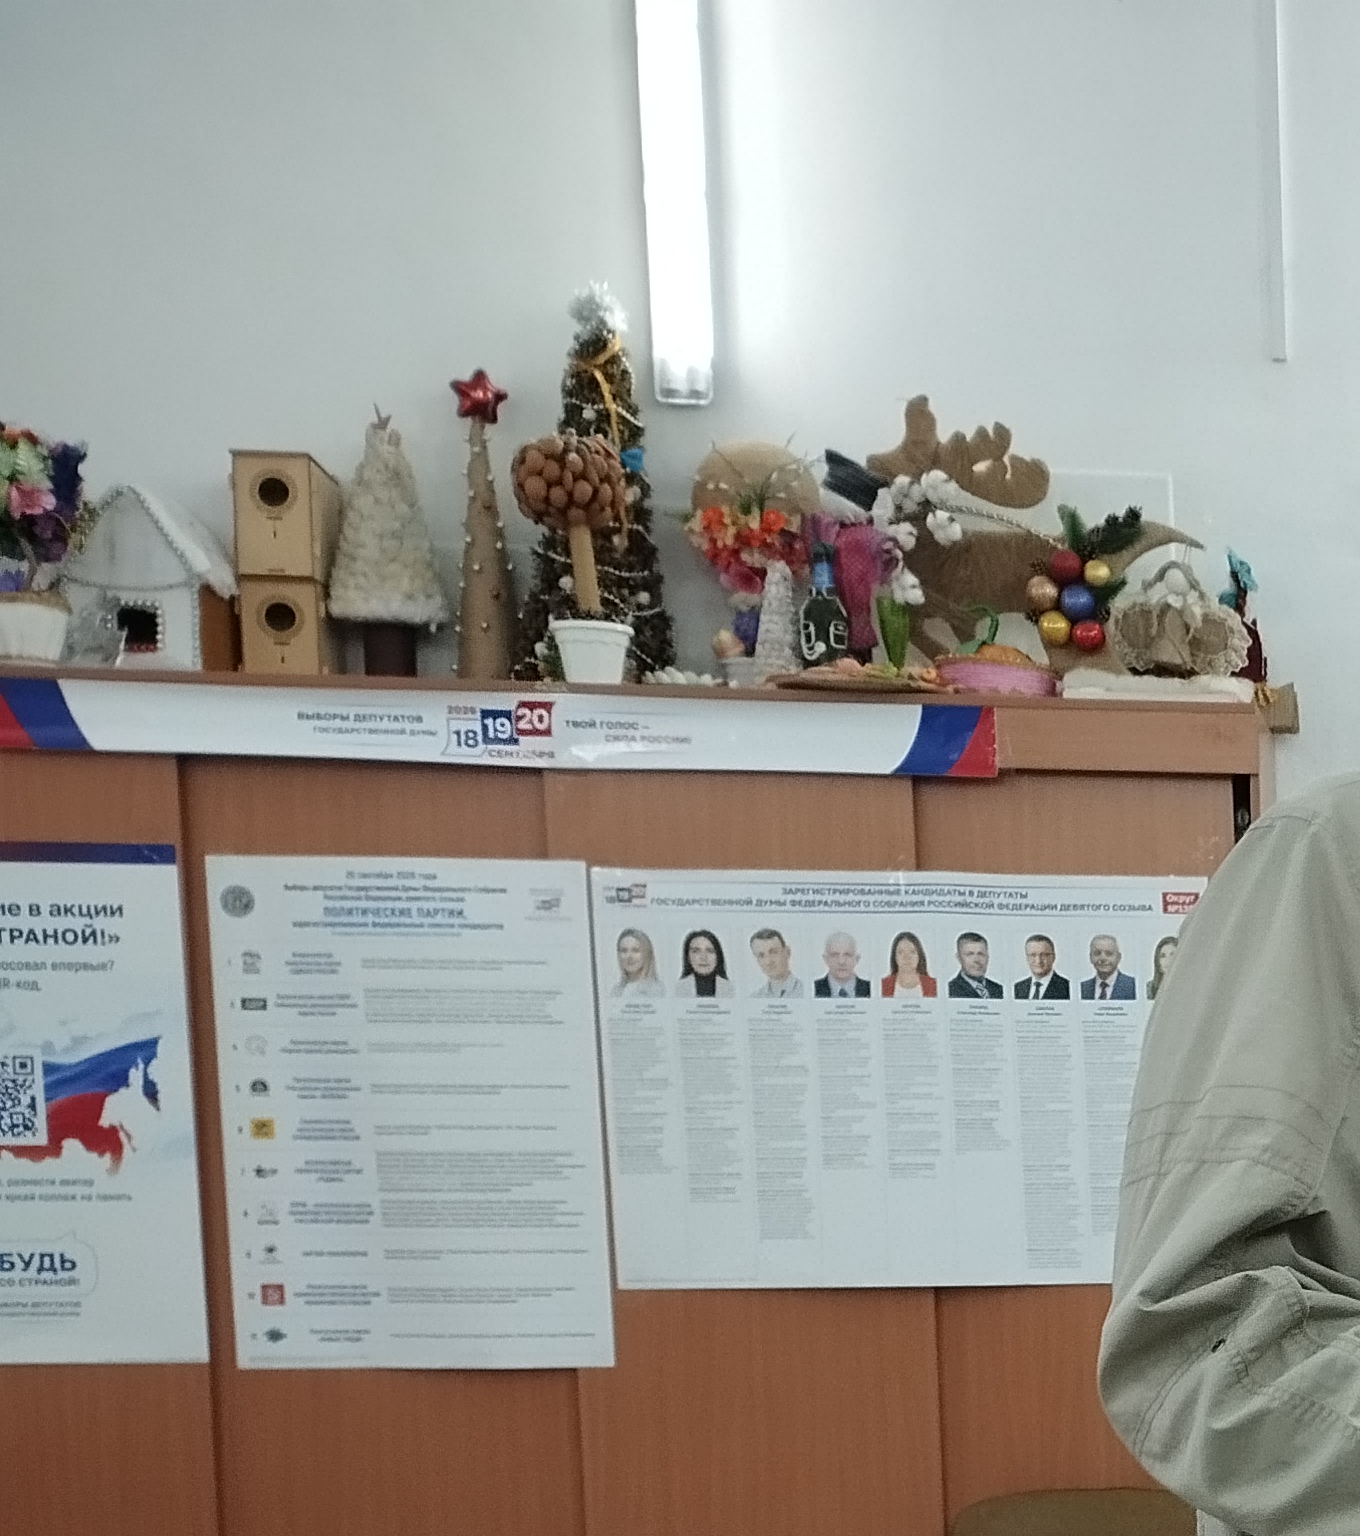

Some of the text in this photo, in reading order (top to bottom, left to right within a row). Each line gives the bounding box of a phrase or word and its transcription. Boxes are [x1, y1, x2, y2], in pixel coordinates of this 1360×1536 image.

[297, 711, 424, 724] ВЫБОРЫ ДЕПУТАТОВ
[453, 706, 550, 749] 18 19 20
[565, 718, 597, 730] ТВОЙ
[600, 721, 640, 731] ГОЛОС
[904, 888, 966, 897] КАНДИДАТЫ
[976, 890, 1028, 899] ДЕПУТАТЫ
[28, 903, 42, 918] в
[49, 903, 124, 920] акции
[789, 899, 871, 908] ФЕДЕРАЛЬНОГО
[928, 899, 994, 909] РОССИЙСКОЙ
[997, 902, 1058, 911] ФЕДЕРАЦИИ
[1059, 903, 1110, 911] ДЕВЯТОГО
[1112, 903, 1154, 912] СОЗЫВА
[0, 1252, 78, 1275] БУДЬ
